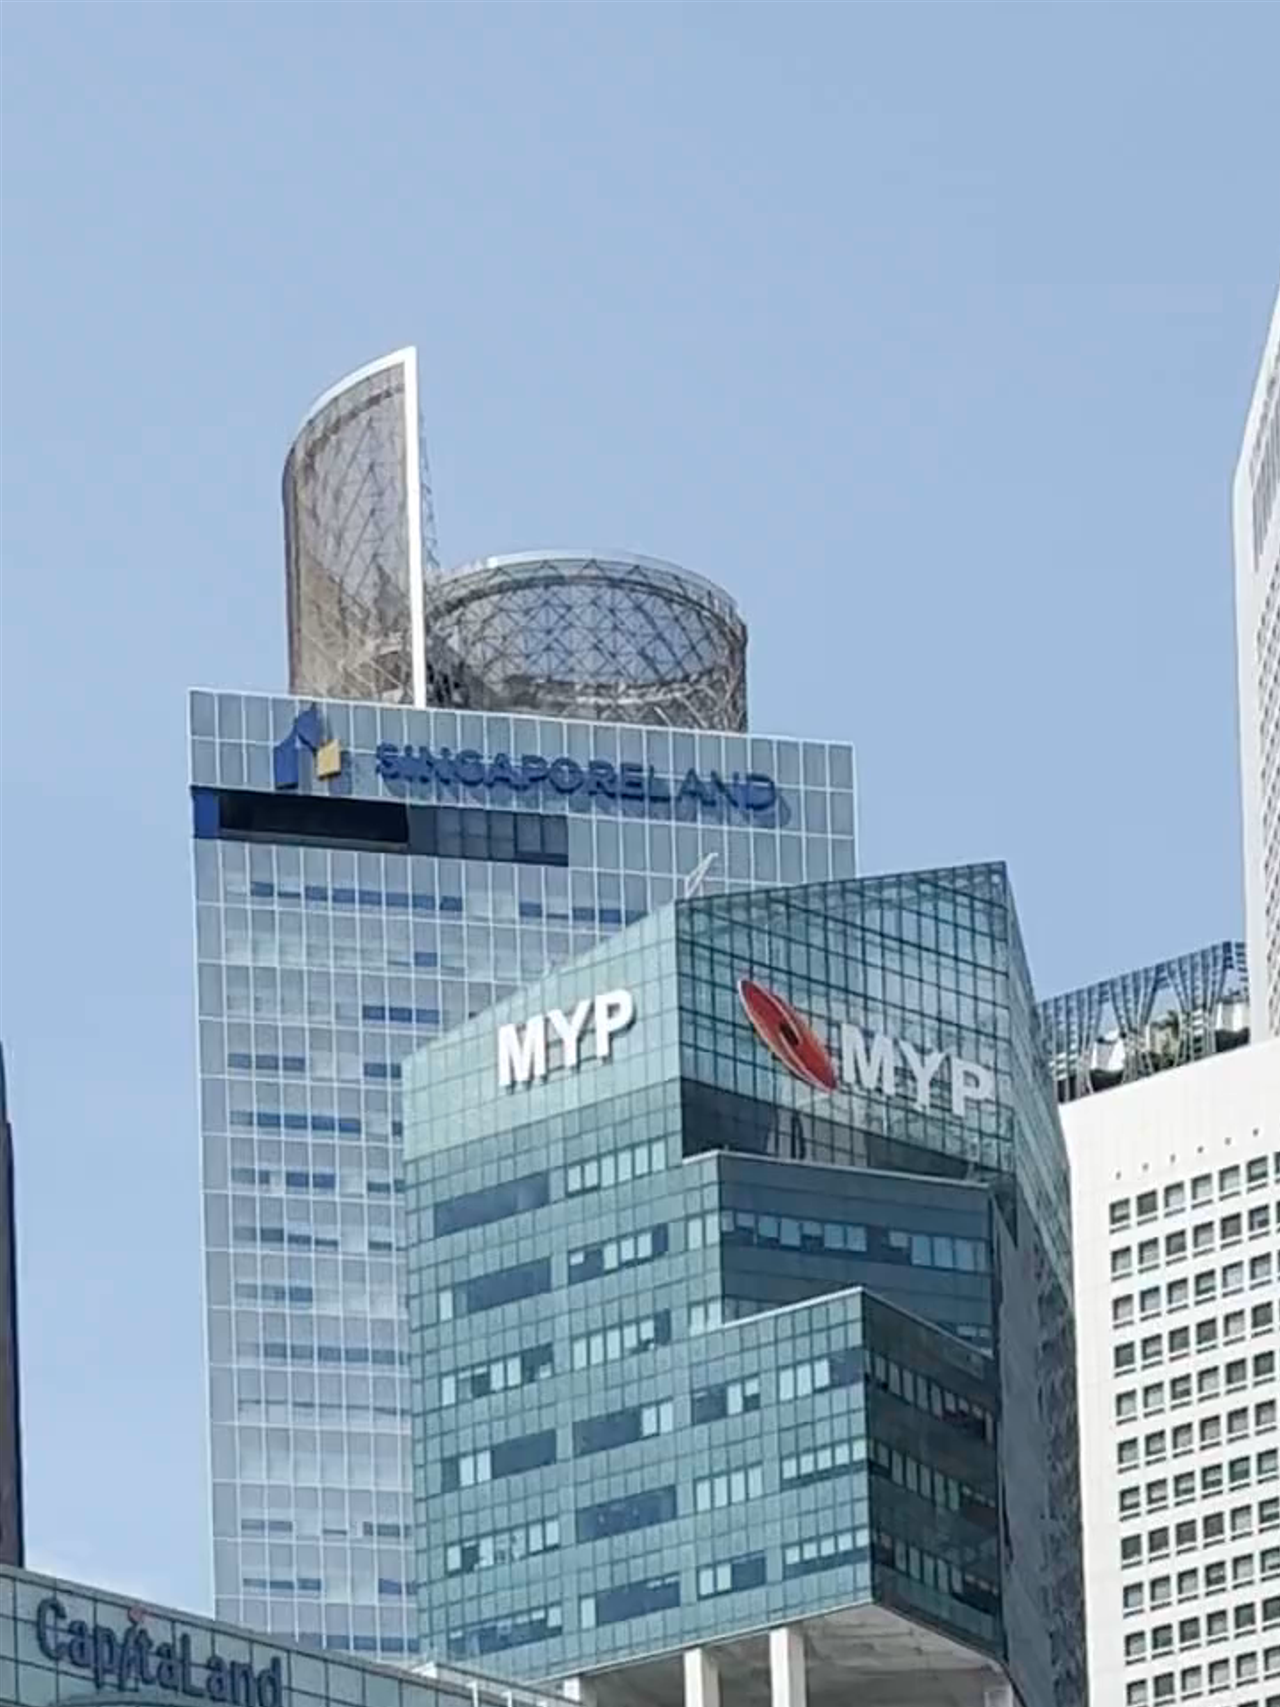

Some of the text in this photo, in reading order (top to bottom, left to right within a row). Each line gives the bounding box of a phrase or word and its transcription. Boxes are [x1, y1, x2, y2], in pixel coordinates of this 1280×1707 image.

[375, 742, 777, 812] SINGAPORELAND
[499, 988, 634, 1088] MYP
[840, 1023, 997, 1116] MYP
